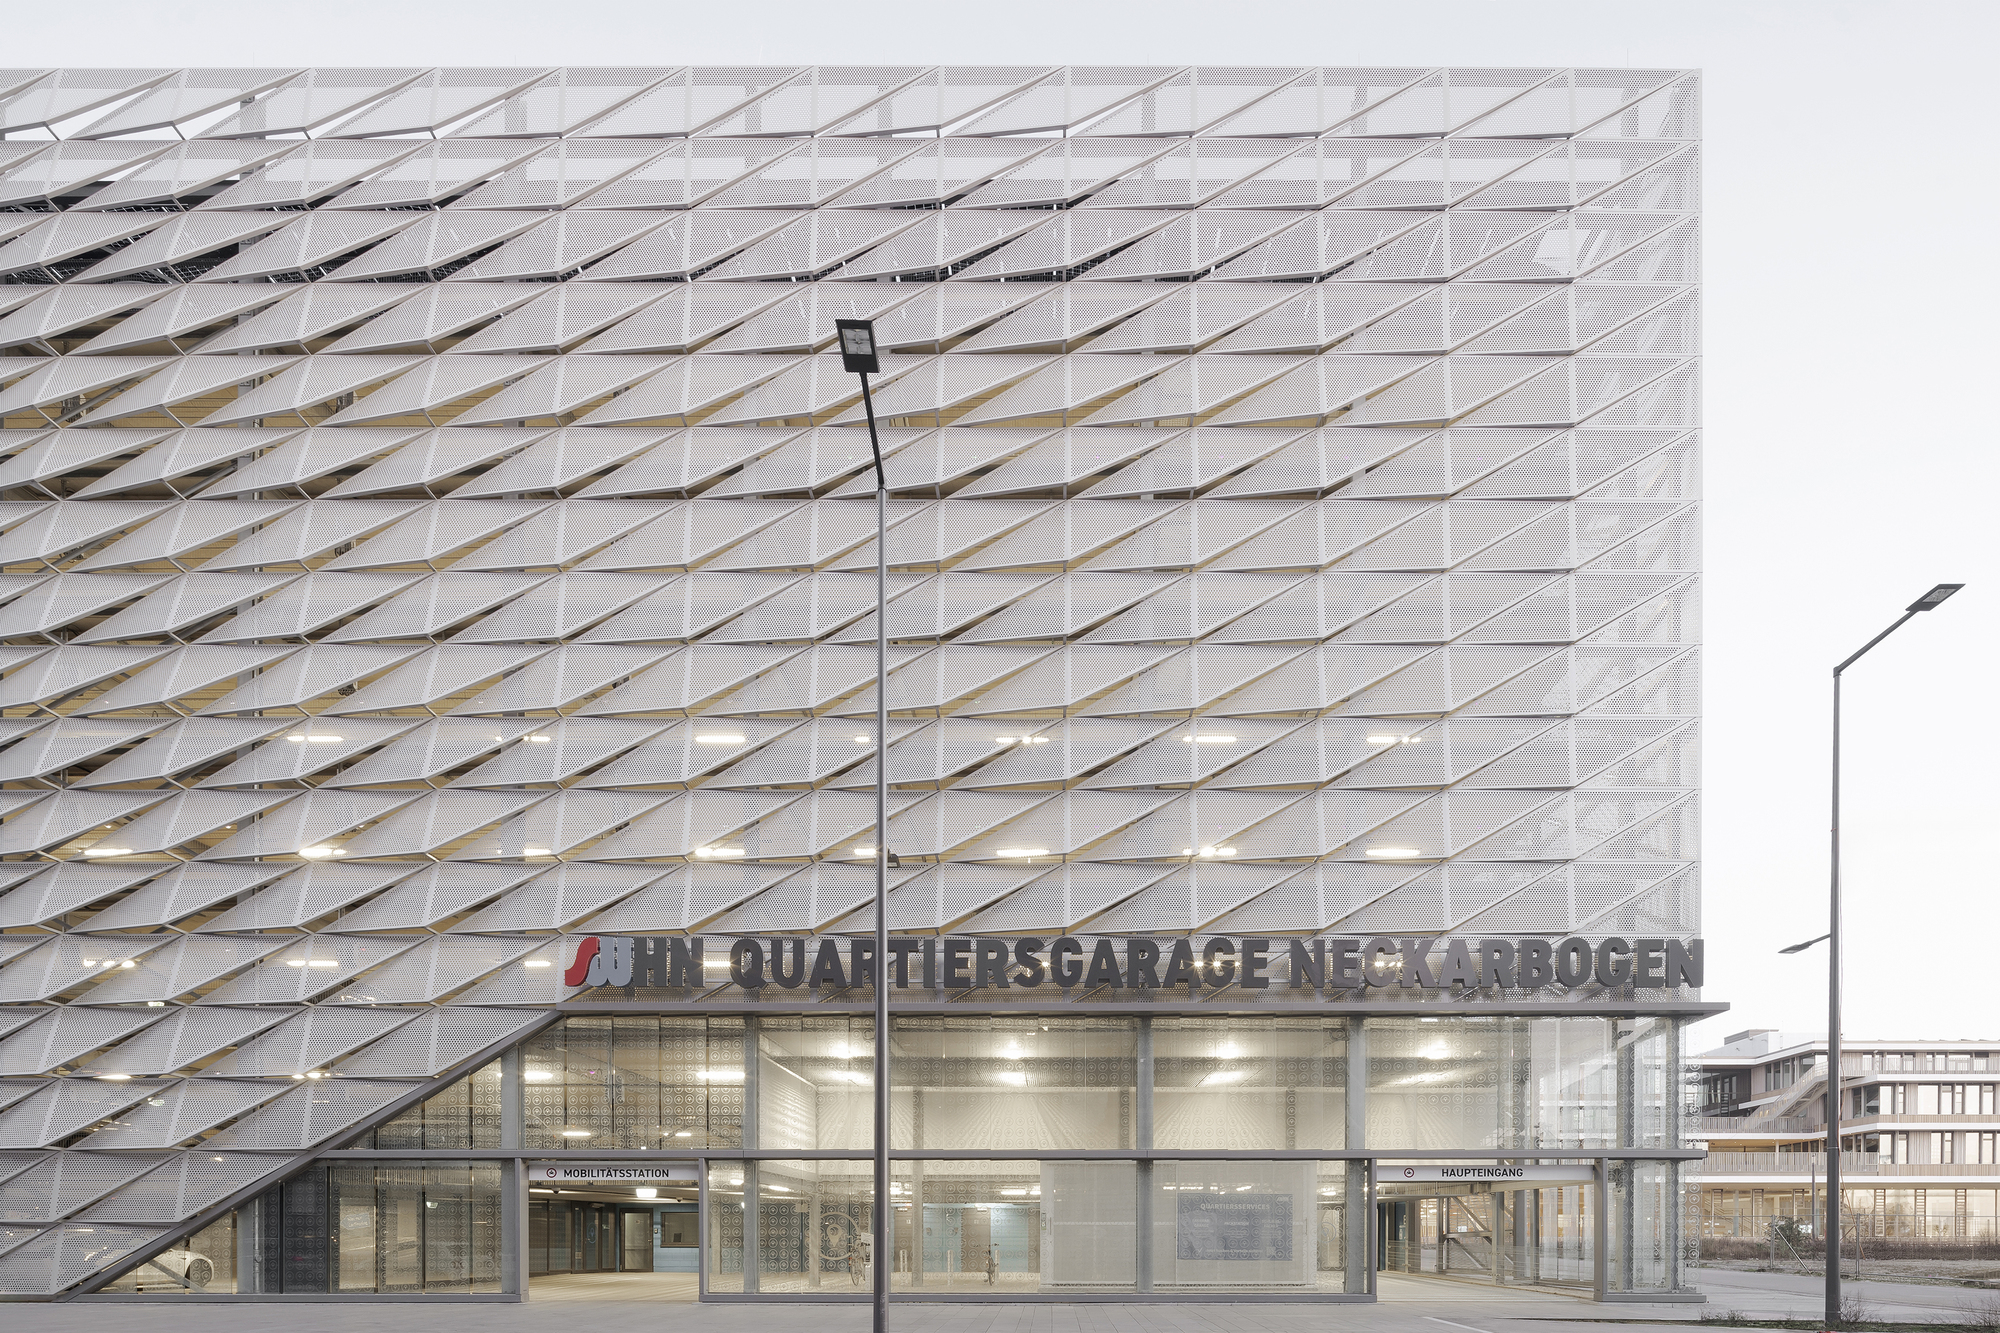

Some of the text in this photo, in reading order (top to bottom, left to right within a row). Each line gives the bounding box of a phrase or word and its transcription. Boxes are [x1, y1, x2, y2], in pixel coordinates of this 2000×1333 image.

[730, 937, 1269, 989] QUARTIERSGARAGE
[1291, 937, 1704, 988] NECKARBOGEN
[563, 1166, 669, 1178] MOBILITÄTSSTATION
[1441, 1168, 1524, 1177] HAUPTEINGANG
